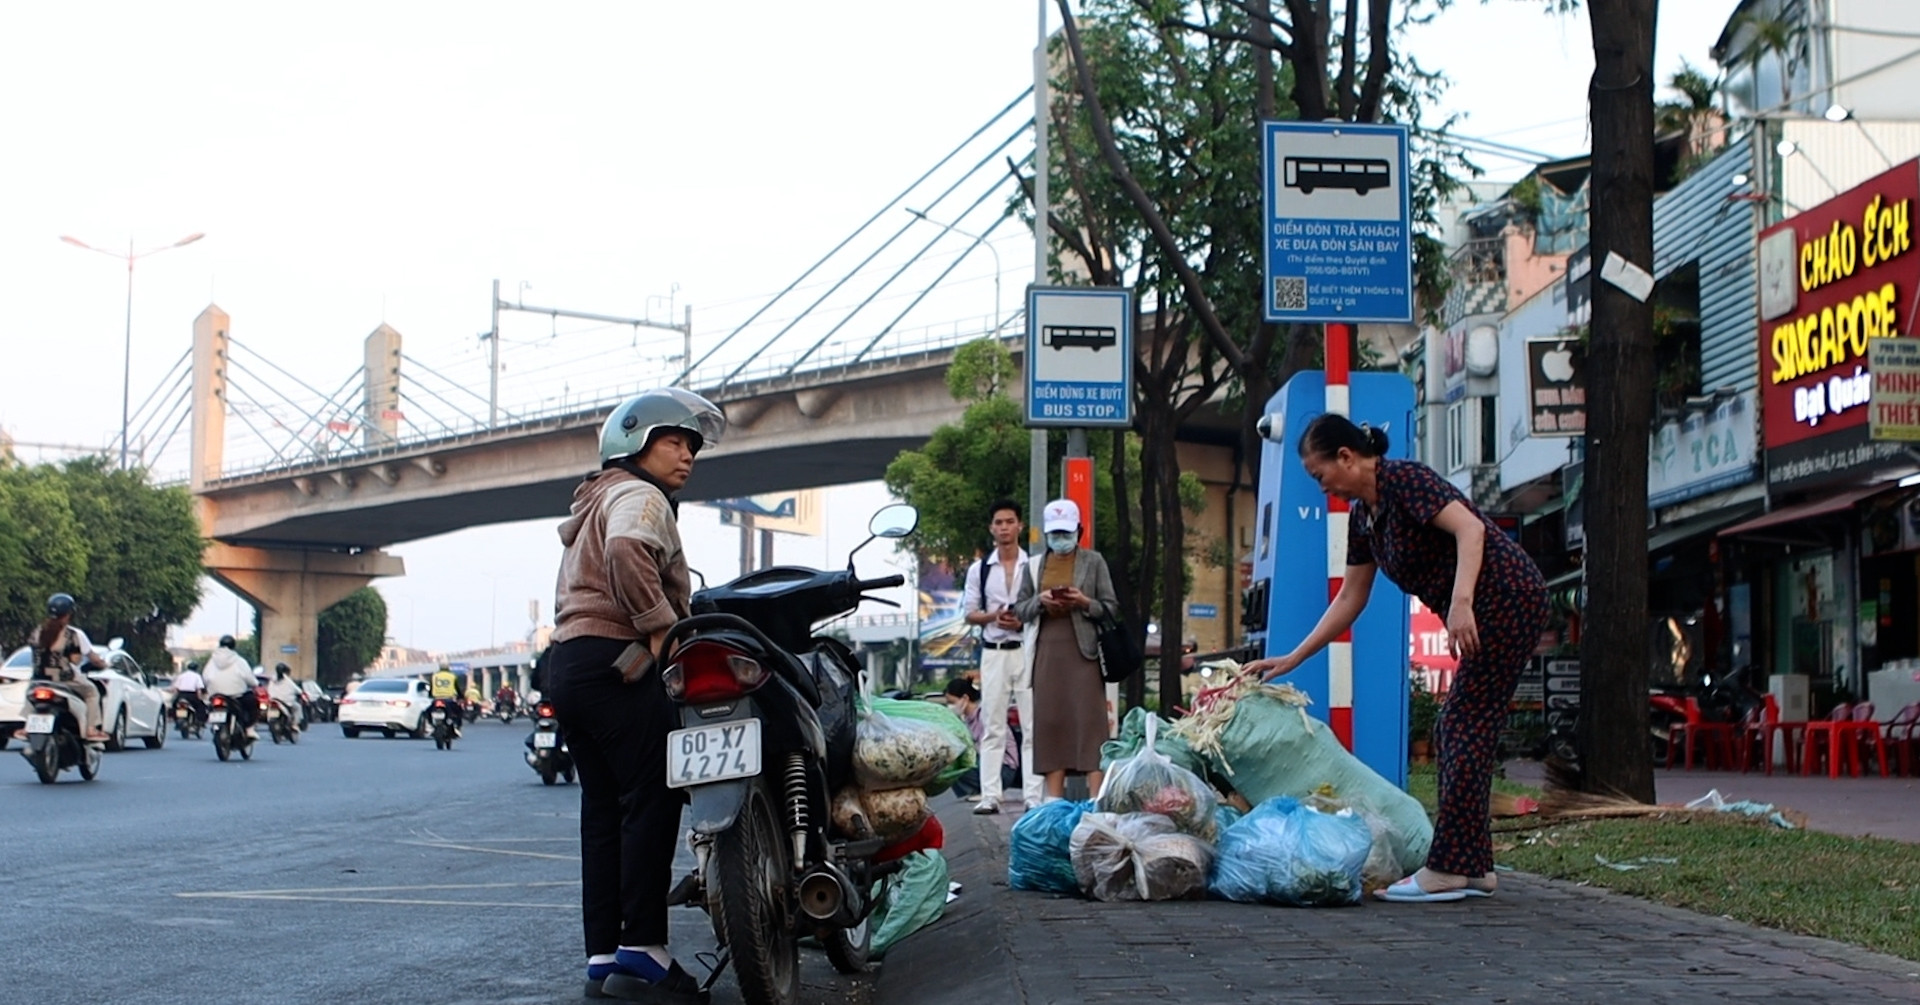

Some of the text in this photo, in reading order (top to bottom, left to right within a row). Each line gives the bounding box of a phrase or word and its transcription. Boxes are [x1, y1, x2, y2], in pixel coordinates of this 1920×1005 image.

[1274, 220, 1400, 238] ĐIỂM ĐÓN TRẢ KHÁCH
[1275, 237, 1399, 252] XE ĐƯA ĐÓN SÂN BAY
[1800, 219, 1856, 293] CHÁO
[1771, 282, 1898, 385] SINGAPORE
[1035, 383, 1058, 400] ĐIỂM
[1086, 387, 1098, 400] XE
[1100, 385, 1123, 401] BUÝT
[1794, 381, 1826, 427] Đạt
[1043, 403, 1115, 418] BUS STOP
[1691, 427, 1739, 474] TCA
[701, 706, 730, 715] HONDA
[681, 724, 747, 756] 60-X7
[680, 749, 747, 782] 4274
